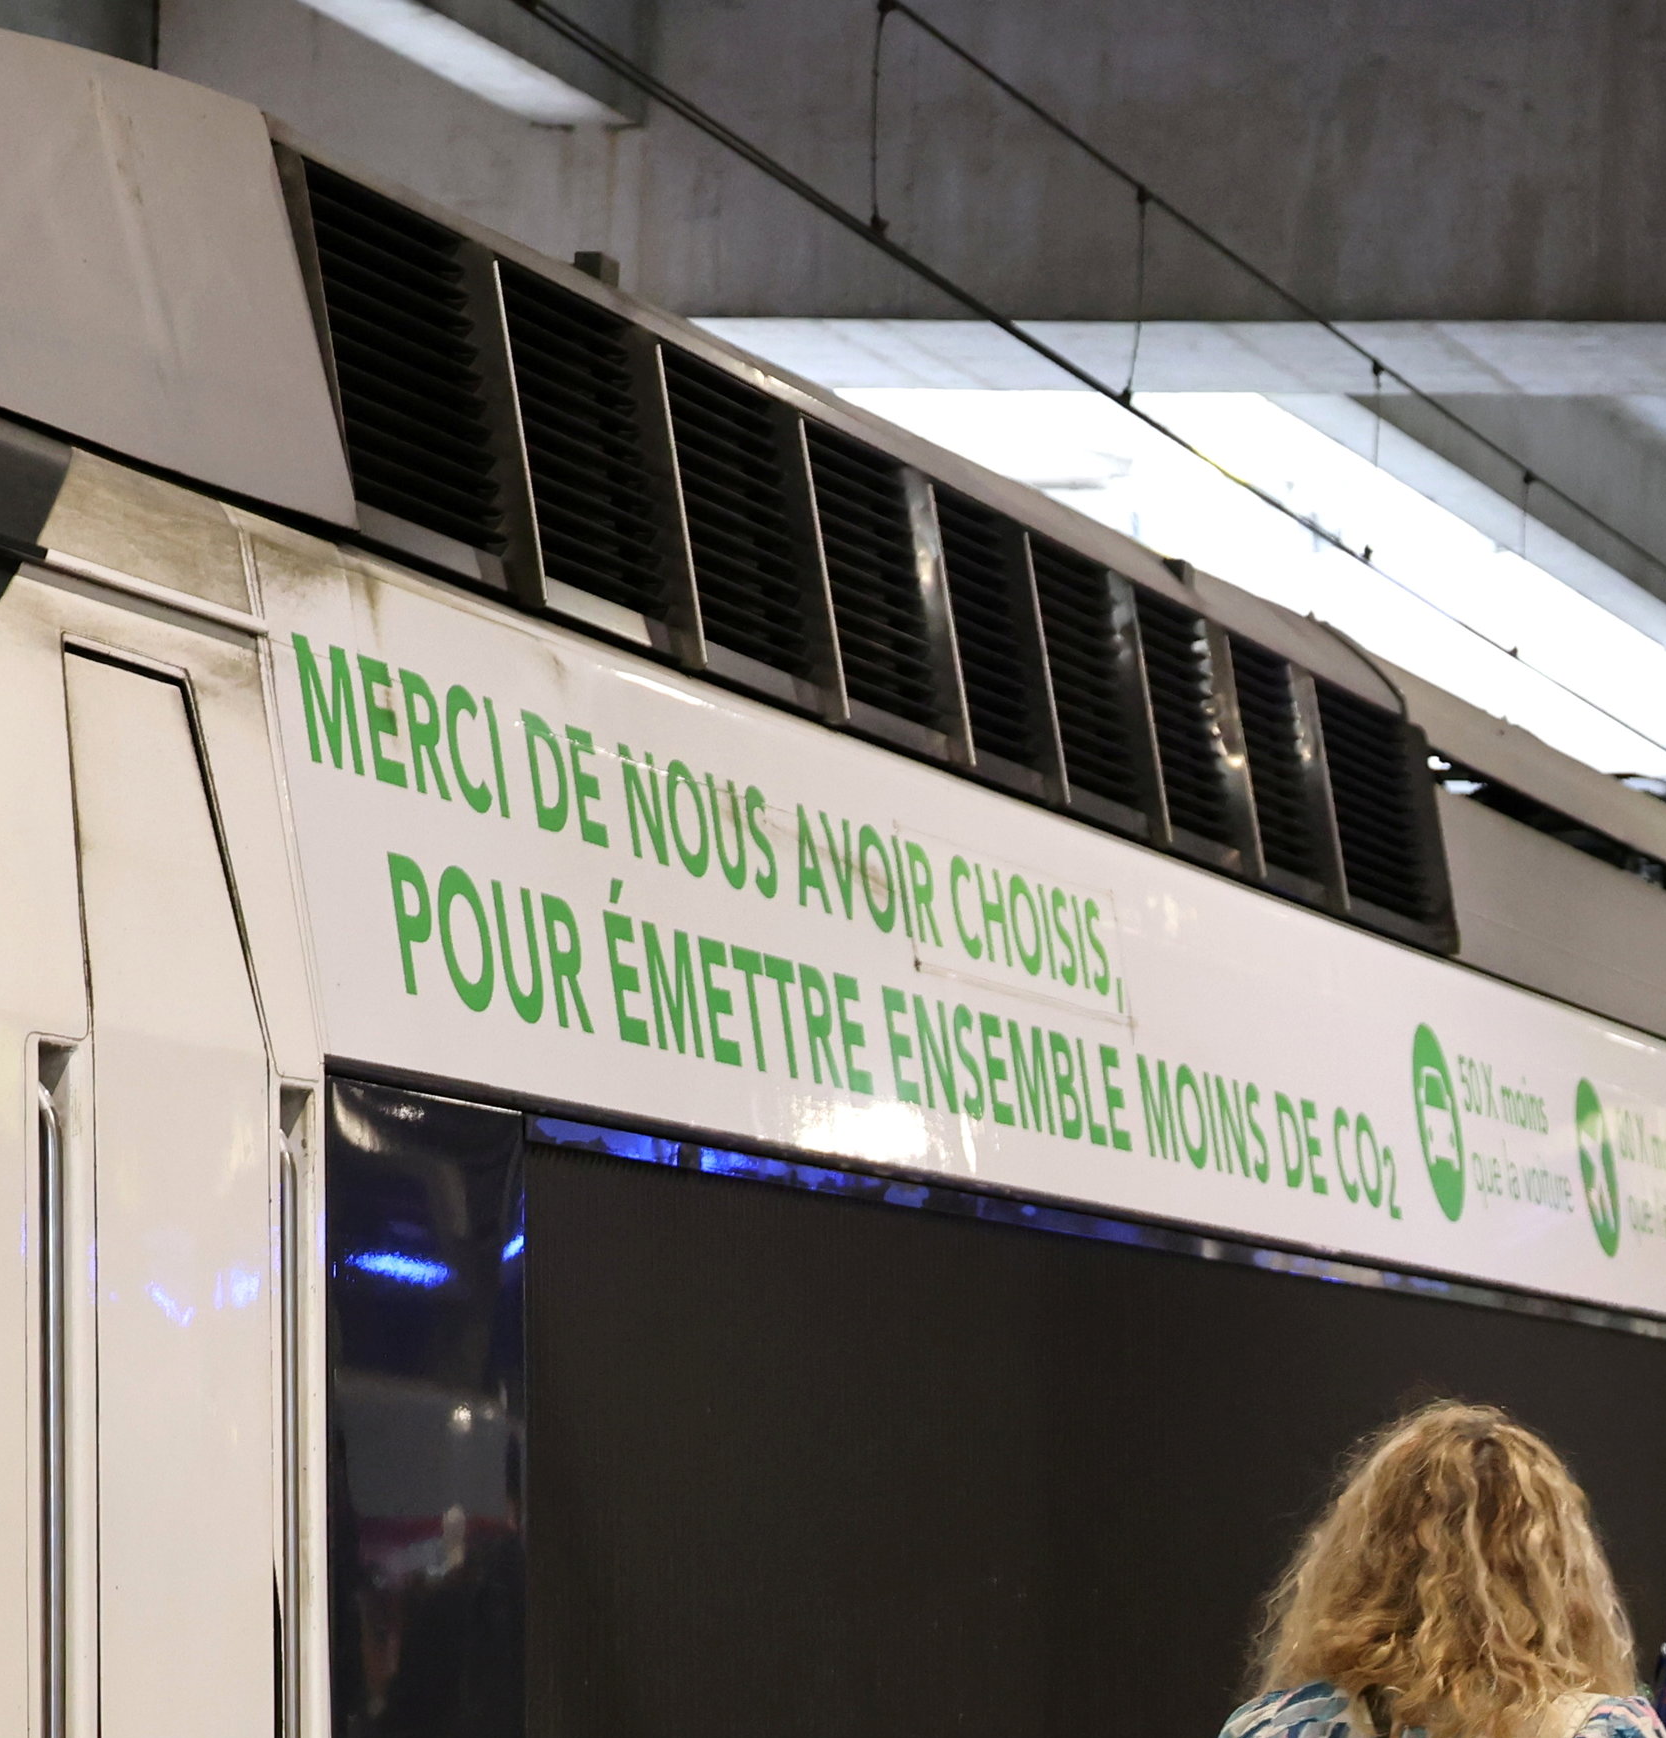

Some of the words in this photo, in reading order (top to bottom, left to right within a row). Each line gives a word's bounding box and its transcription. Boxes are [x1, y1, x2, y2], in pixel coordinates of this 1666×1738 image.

[290, 632, 511, 819] MERCI
[520, 708, 608, 849] DE
[617, 743, 779, 900] NOUS
[795, 801, 943, 949] AVOIR
[948, 854, 1126, 1016] CHOISIS,
[387, 851, 594, 1036] POUR
[602, 878, 874, 1097] ÉMETTRE
[880, 985, 1133, 1153] ENSEMBLE
[1135, 1053, 1271, 1185] MOINS
[1274, 1091, 1329, 1197] DE
[1457, 1054, 1482, 1115] 50
[1501, 1075, 1549, 1135] moins
[1471, 1151, 1503, 1208] que
[1502, 1138, 1521, 1200] la
[1522, 1153, 1575, 1213] voiture
